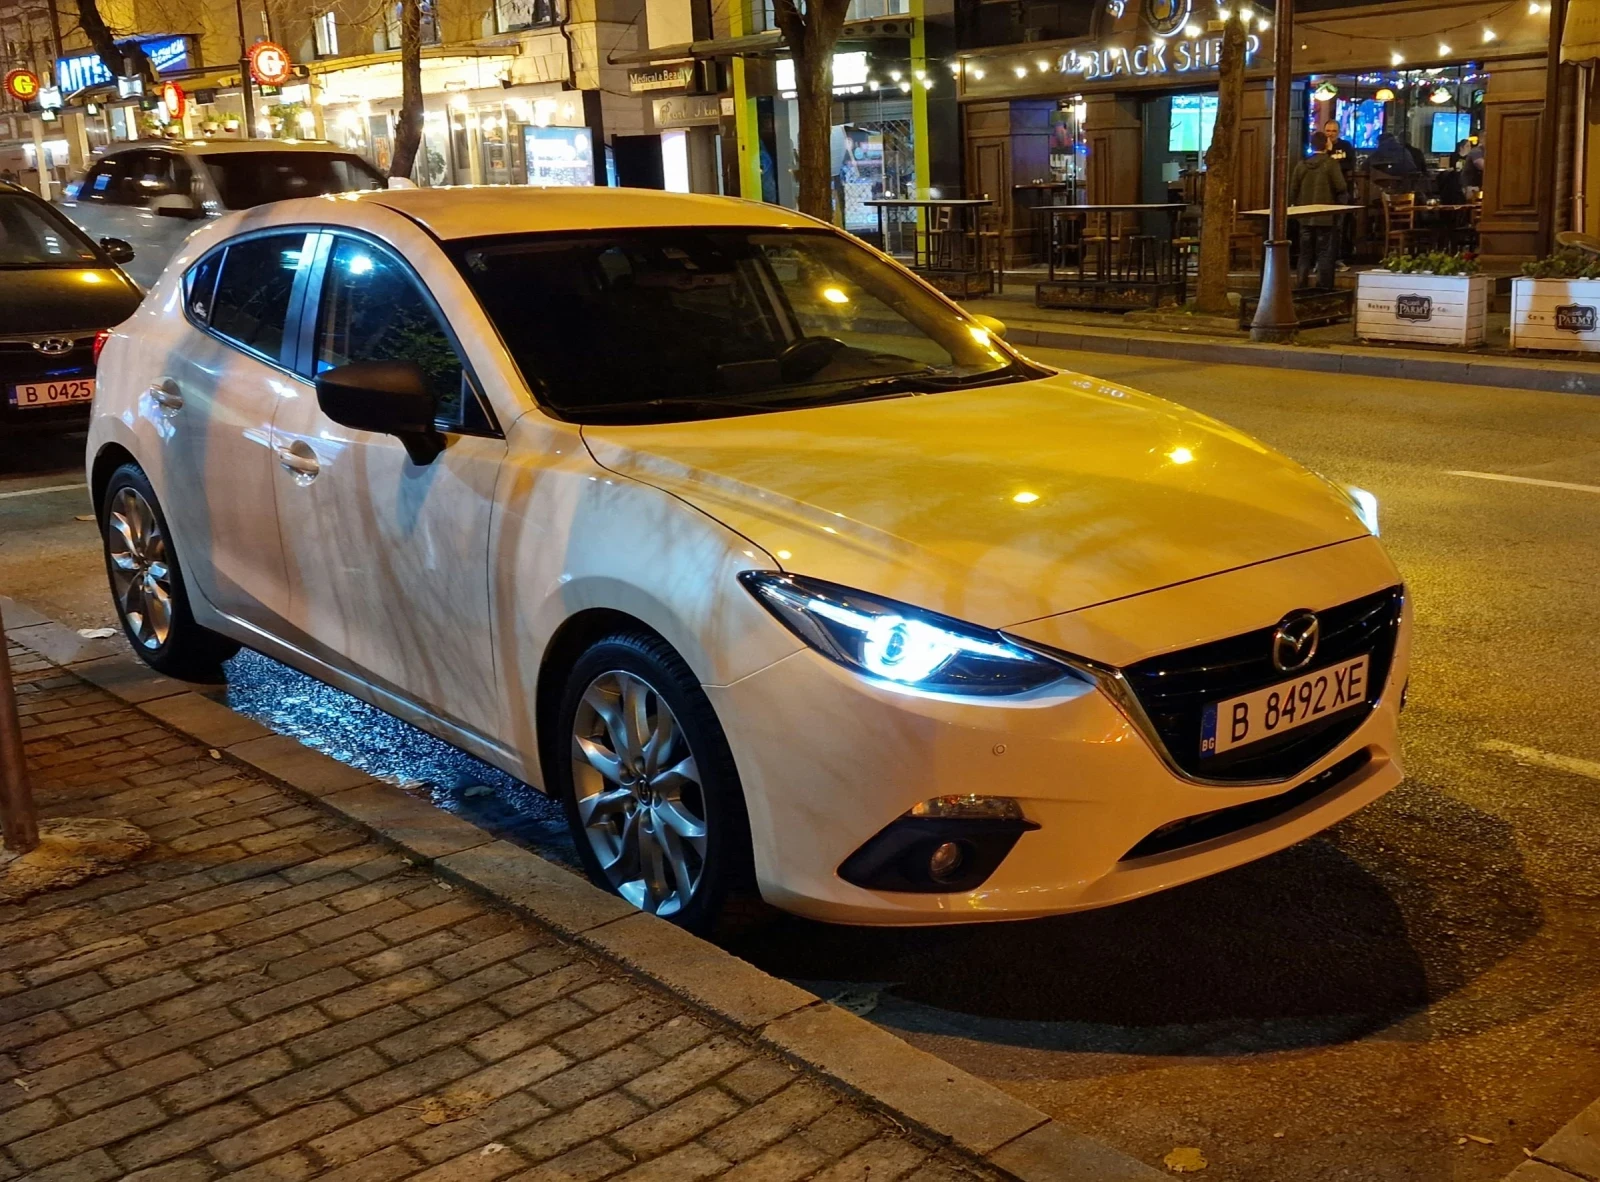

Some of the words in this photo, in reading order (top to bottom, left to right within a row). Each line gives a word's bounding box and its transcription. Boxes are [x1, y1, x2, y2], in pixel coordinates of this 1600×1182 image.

[1084, 43, 1167, 79] BLACK
[1174, 35, 1259, 71] SHEP
[14, 75, 36, 94] G
[630, 72, 657, 84] Medical
[663, 66, 693, 89] Beauty
[1399, 303, 1429, 315] PARMY
[1558, 314, 1592, 327] PARMY
[26, 386, 38, 402] B
[47, 381, 91, 401] 0425
[1231, 702, 1249, 743] B
[1264, 675, 1328, 731] 8492
[1332, 662, 1364, 707] XE
[1201, 737, 1215, 752] BG
